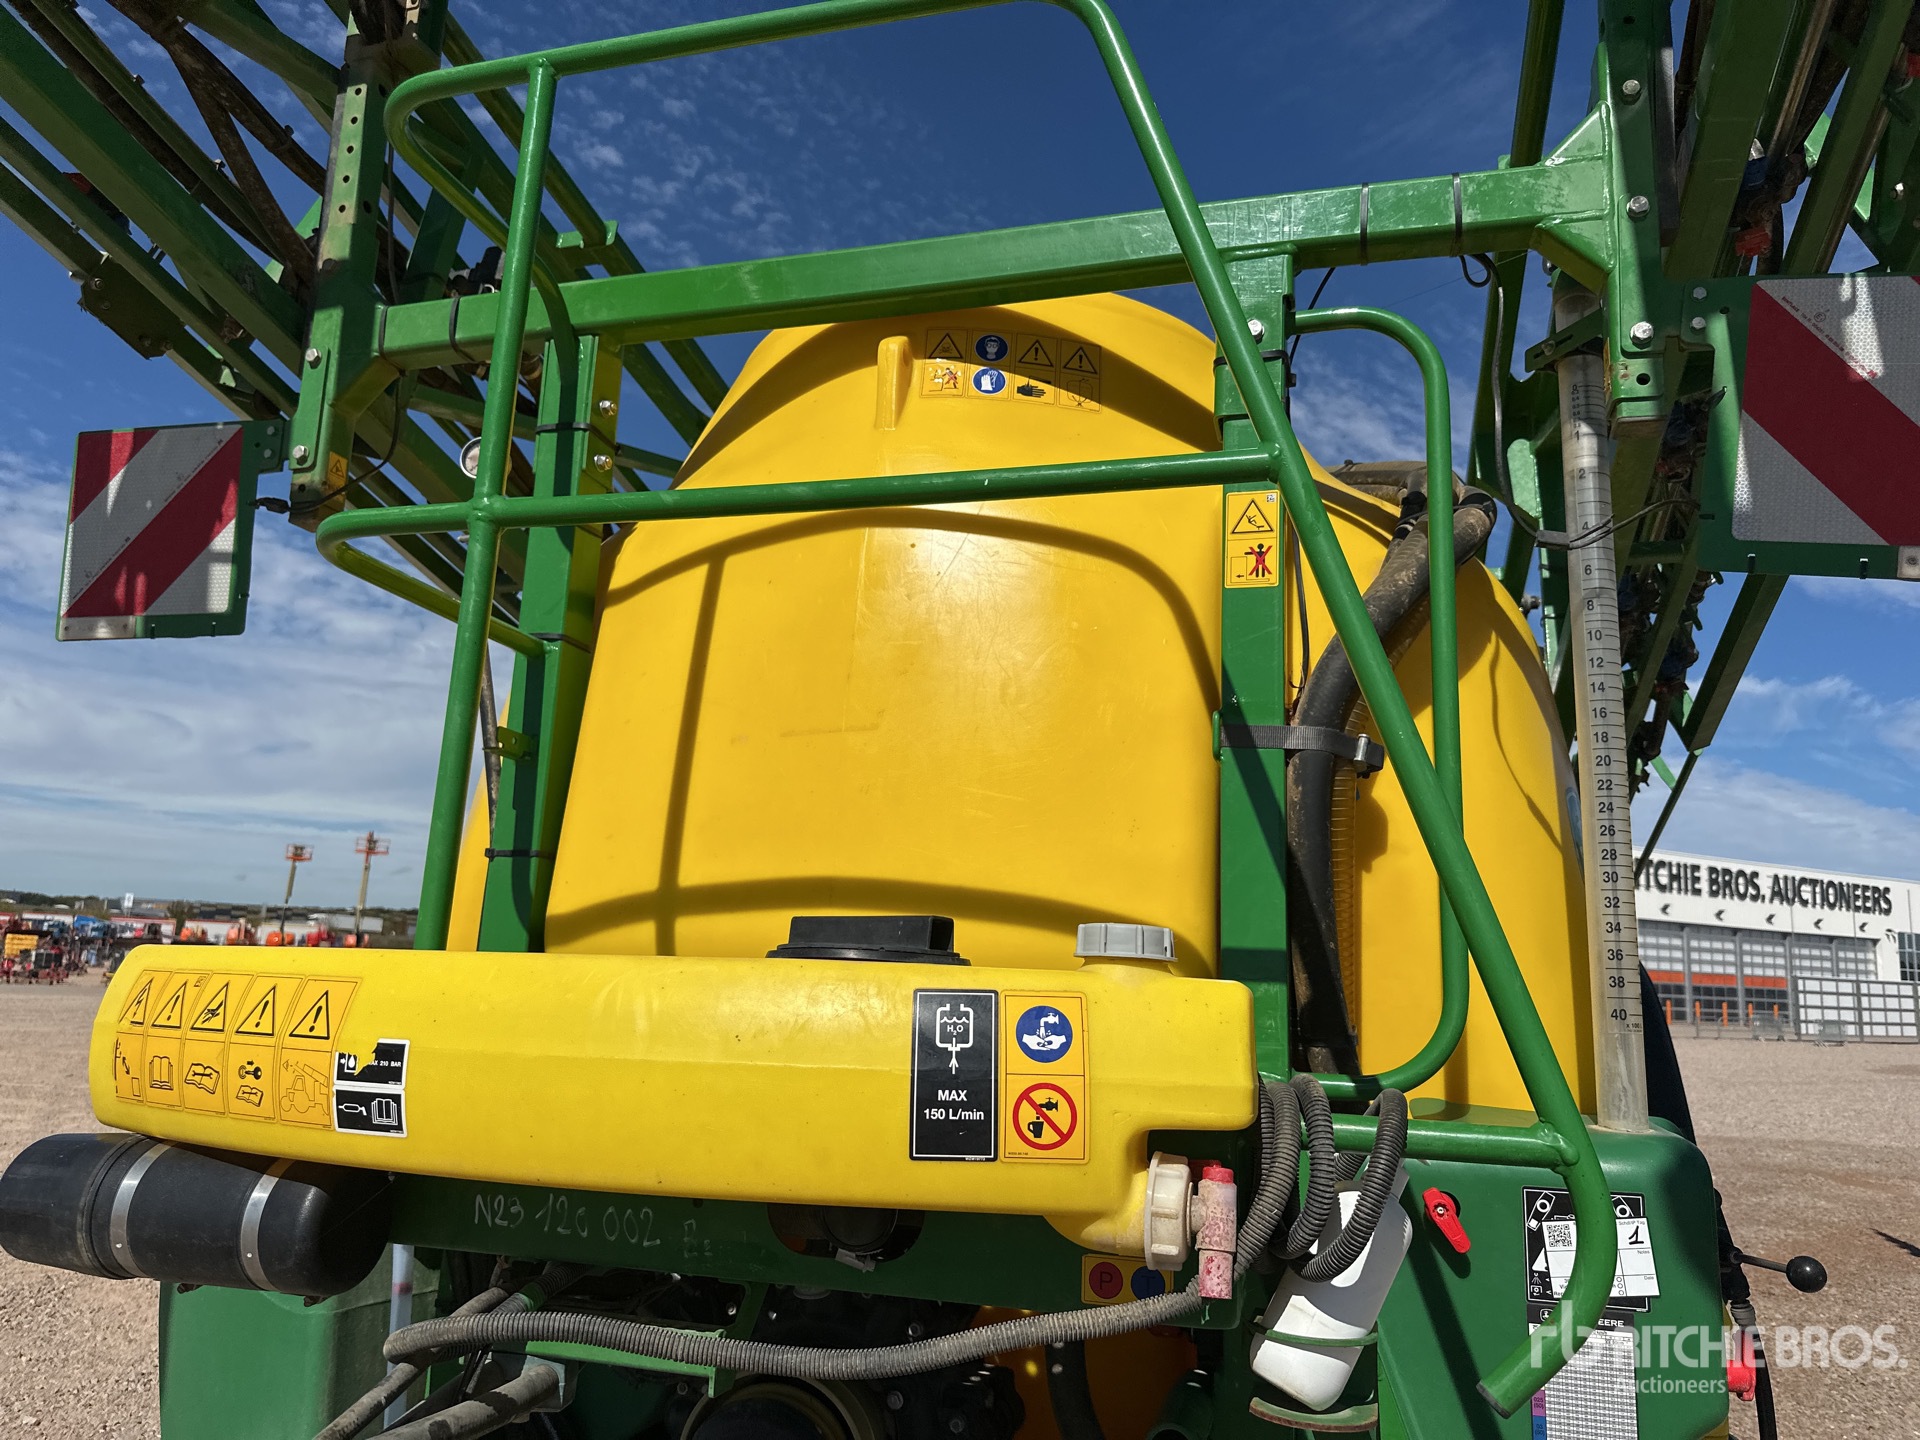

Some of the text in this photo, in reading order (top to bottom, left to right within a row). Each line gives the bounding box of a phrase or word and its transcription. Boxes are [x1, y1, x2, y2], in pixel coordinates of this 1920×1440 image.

[1574, 430, 1580, 440] 1
[1577, 468, 1586, 479] 2
[1581, 520, 1590, 530] 4
[1584, 564, 1592, 576] 6
[1586, 599, 1595, 611] 8
[1587, 629, 1602, 641] 10
[1589, 656, 1604, 668] 12
[1590, 681, 1606, 693] 14
[1591, 707, 1607, 719] 16
[1593, 731, 1609, 743] 18
[1595, 755, 1611, 767] 20
[1597, 779, 1613, 791] 22
[1598, 801, 1614, 814] 24
[1600, 825, 1616, 837] 26
[1601, 849, 1617, 861] 28
[1602, 872, 1619, 883] 30
[1708, 866, 1765, 903] BROS.
[1769, 874, 1893, 916] AUCTIONEERS
[1604, 896, 1620, 908] 32
[1605, 921, 1622, 933] 34
[1607, 949, 1624, 961] 36
[1608, 976, 1625, 988] 38
[1610, 1008, 1627, 1020] 40
[937, 1089, 967, 1101] MAX
[923, 1108, 985, 1121] 150 L/min
[474, 1193, 525, 1229] N23
[602, 1205, 661, 1247] 002
[1628, 1225, 1645, 1245] 1
[1098, 1270, 1114, 1290] P
